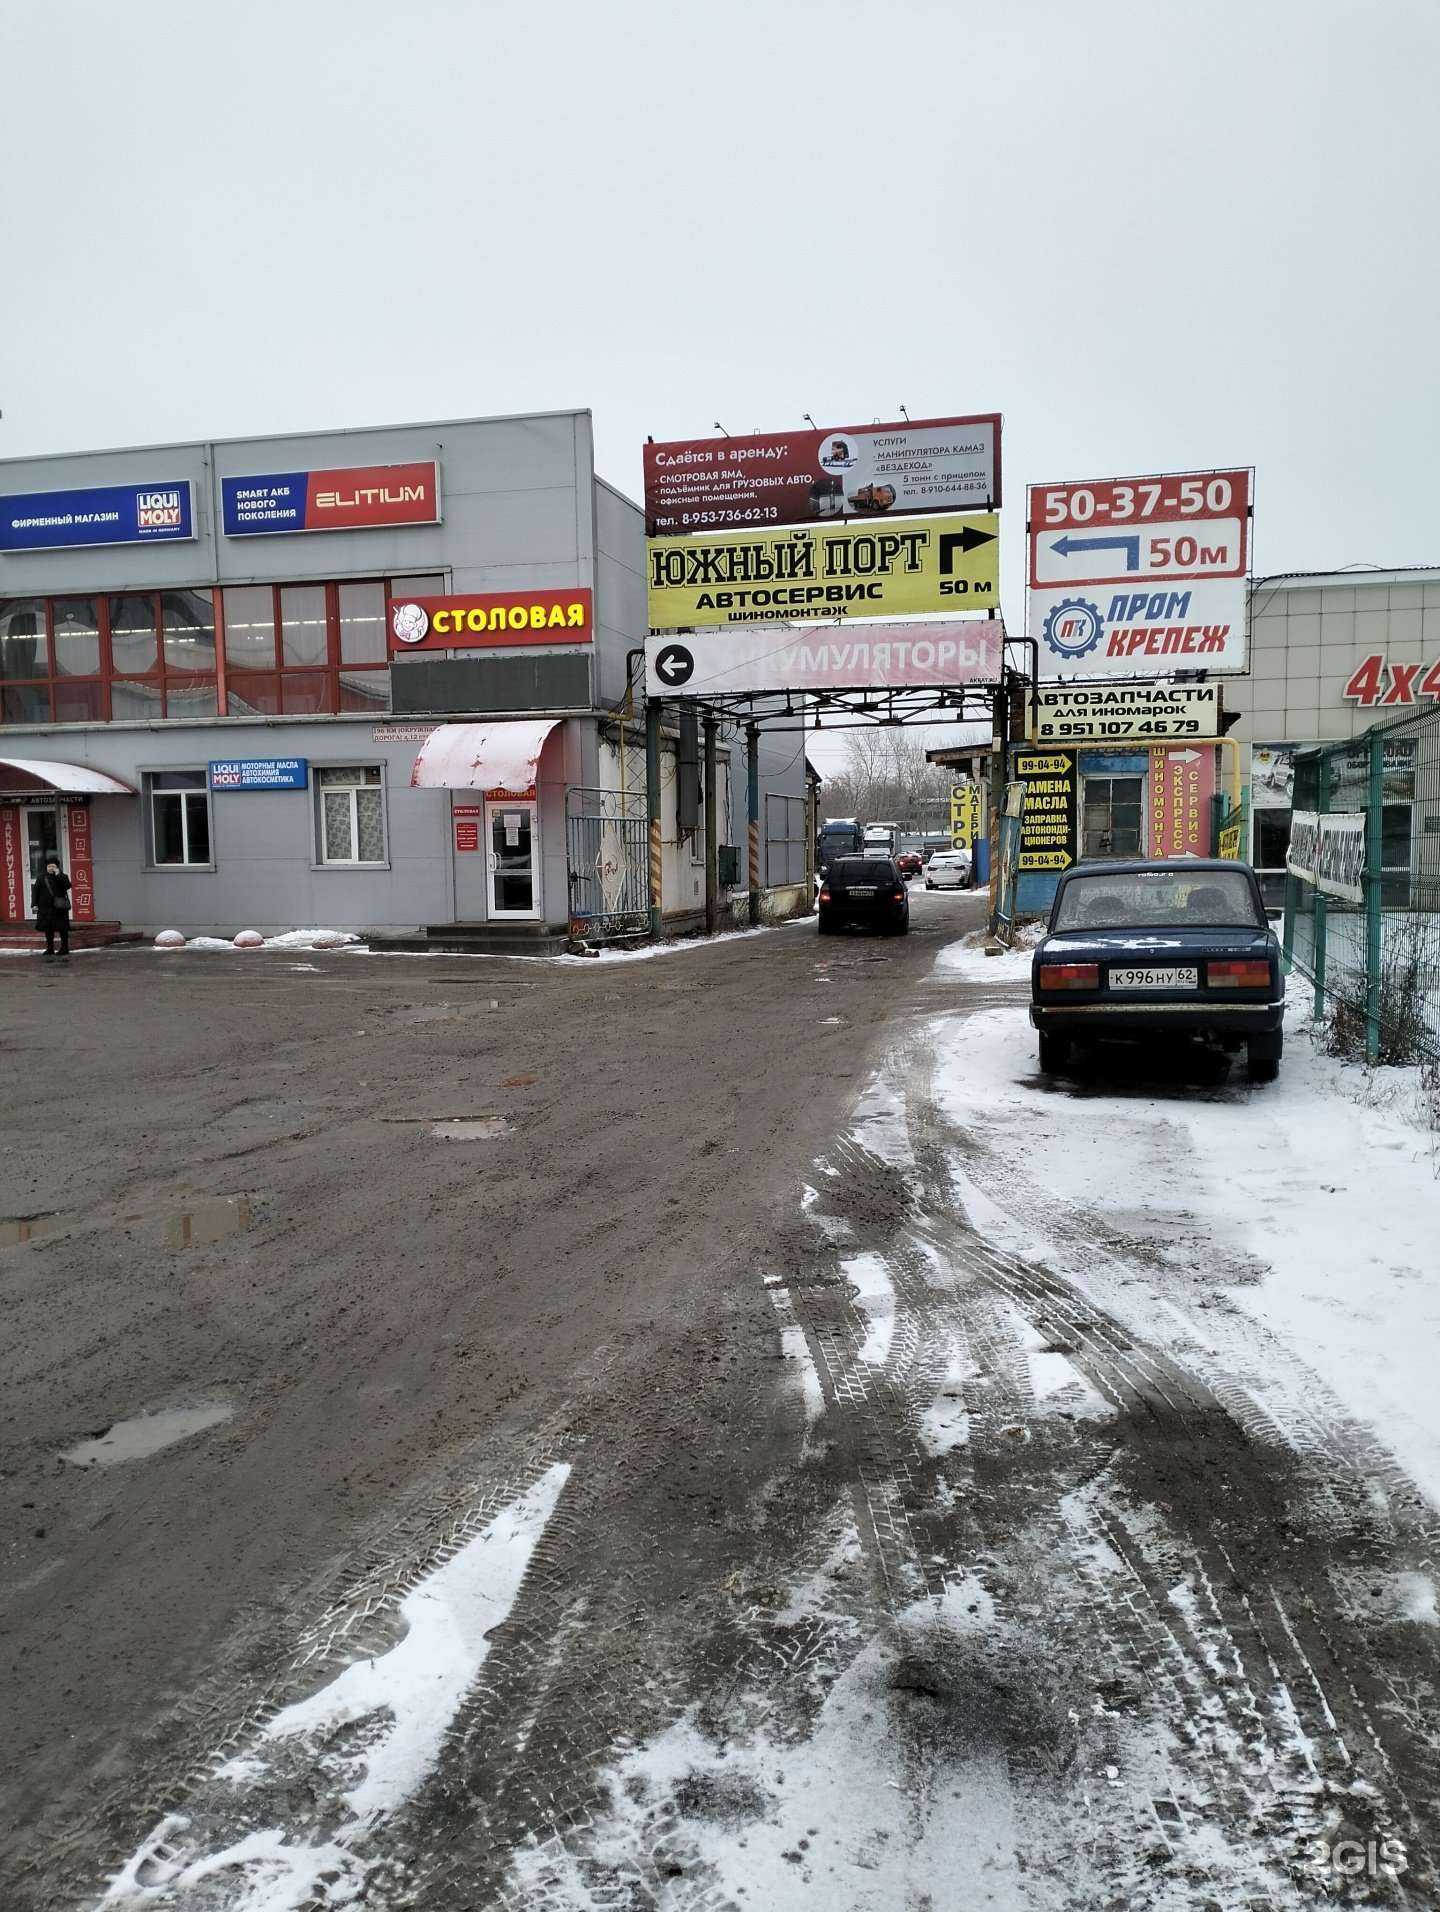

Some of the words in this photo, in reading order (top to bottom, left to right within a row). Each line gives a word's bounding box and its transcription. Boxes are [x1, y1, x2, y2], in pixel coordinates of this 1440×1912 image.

[873, 438, 907, 447] УСЛУГИ
[655, 451, 713, 466] Сдаётся
[718, 453, 725, 461] в
[730, 445, 788, 462] аренду:
[877, 446, 950, 459] МАНИПУЛЯТОРА
[952, 443, 985, 453] КАМАЗ
[660, 472, 718, 484] СМОТРОВАЯ
[713, 483, 730, 492] для
[733, 476, 784, 488] ГРУЗОВЫХ
[903, 475, 909, 483] 5
[140, 493, 178, 509] LIQUI
[236, 488, 268, 499] SMART
[270, 487, 290, 496] АКБ
[316, 485, 424, 508] ELITIUM
[1045, 478, 1232, 524] 50-37-50
[237, 499, 276, 510] НОВОГО
[11, 514, 72, 529] ФИРМЕННЫЙ
[74, 512, 119, 524] МАГАЗИН
[140, 509, 179, 524] MOLY
[238, 509, 296, 521] ПОКОЛЕНИЯ
[656, 516, 678, 526] тел.
[682, 507, 778, 525] 8-953-736-62-13
[651, 529, 816, 589] ЮЖНЫЙ
[823, 530, 930, 579] ПОРТ
[696, 583, 882, 610] АВТОСЕРВИС
[1106, 591, 1192, 622] ПРОМ
[432, 603, 584, 634] СТОЛОВАЯ
[1106, 624, 1231, 657] КРЕПЕЖ
[1028, 688, 1214, 706] АВТОЗАПЧАСТИ
[1041, 723, 1054, 737] 8
[1138, 720, 1168, 734] 46
[1173, 719, 1200, 733] 79
[212, 764, 239, 774] LIQUI
[241, 762, 275, 770] МОТОРНЫЕ
[276, 761, 299, 769] МАСЛА
[1022, 759, 1065, 771] 99-04-94
[213, 774, 240, 784] MOLY
[1026, 780, 1071, 794] АМЕНА
[1024, 796, 1068, 810] МАСЛА
[1173, 765, 1184, 849] ЭКСПРЕСС
[1188, 770, 1201, 843] СЕРВИС
[1024, 814, 1068, 824] ЗАПРАВКА
[1024, 835, 1067, 847] ЦИОНЕРОВ
[1022, 854, 1065, 866] 99-04-94
[4, 822, 16, 918] АККУМУЛЯТОРЫ
